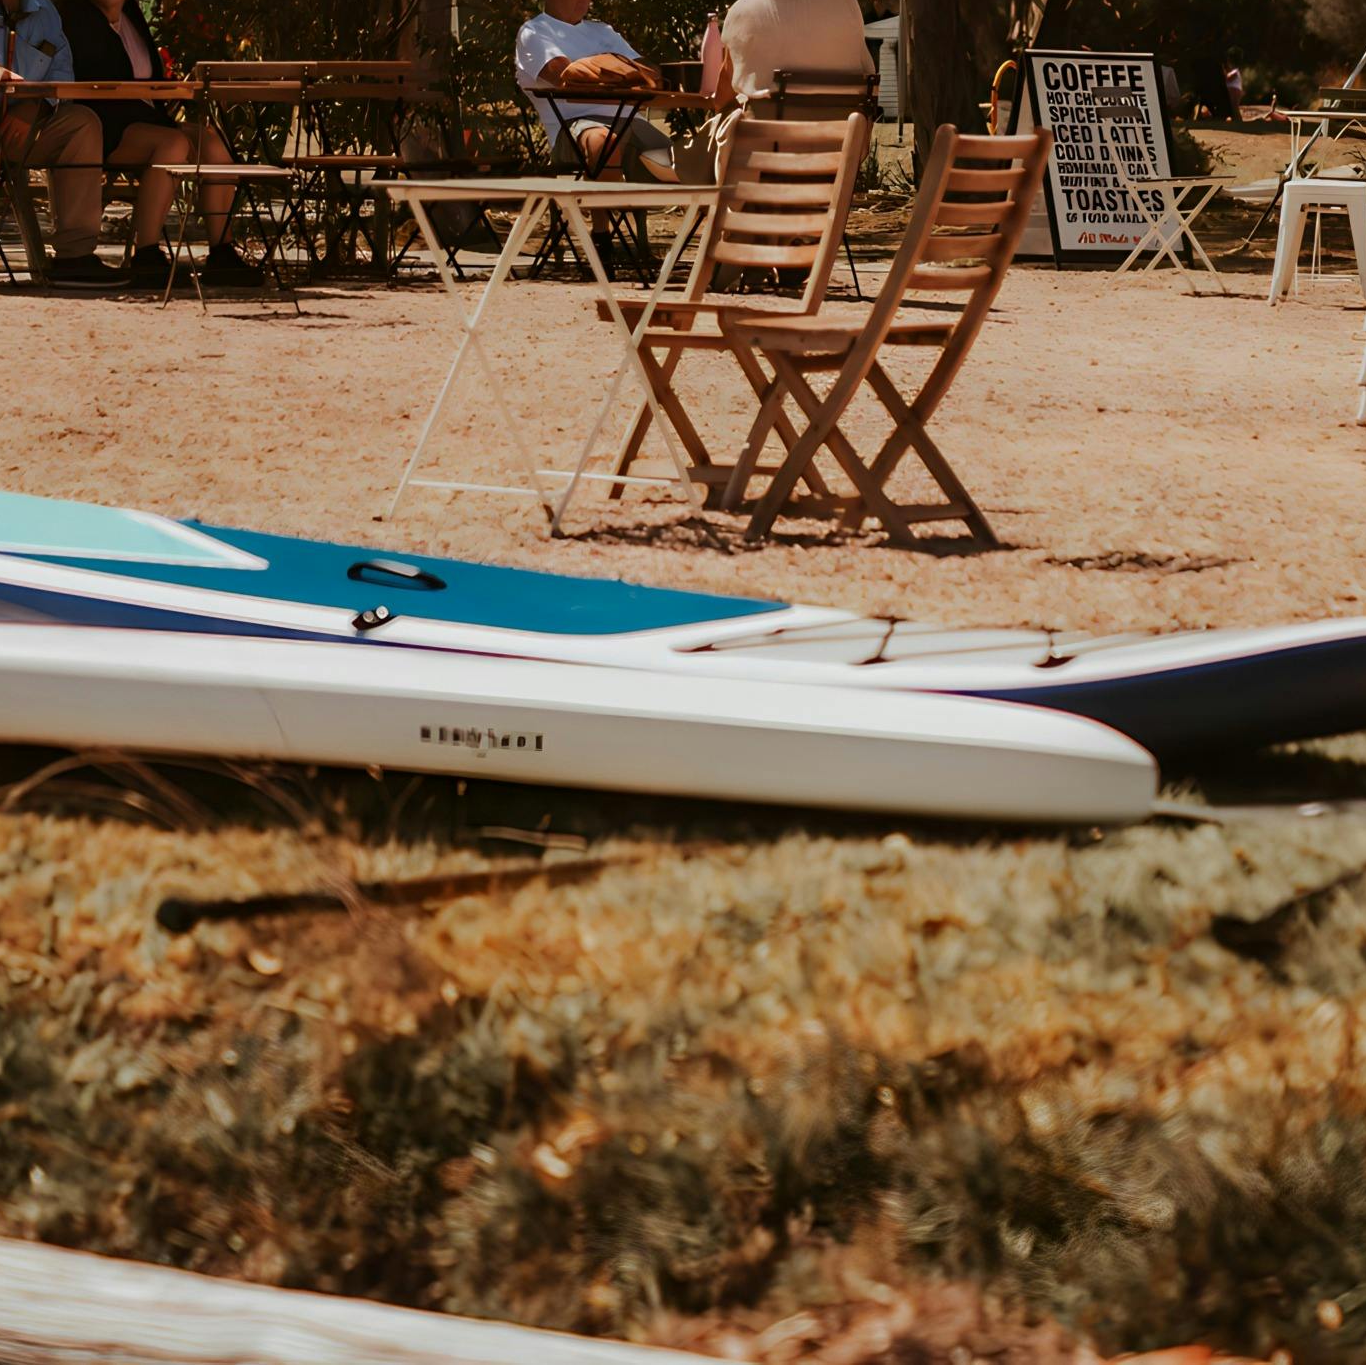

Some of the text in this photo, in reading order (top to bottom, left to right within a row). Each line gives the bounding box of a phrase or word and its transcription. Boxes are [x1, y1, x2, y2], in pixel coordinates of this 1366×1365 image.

[1042, 62, 1146, 92] COFFEE
[1046, 91, 1071, 105] HOT
[1052, 124, 1092, 143] ICED
[1055, 144, 1157, 162] COLD DINKS
